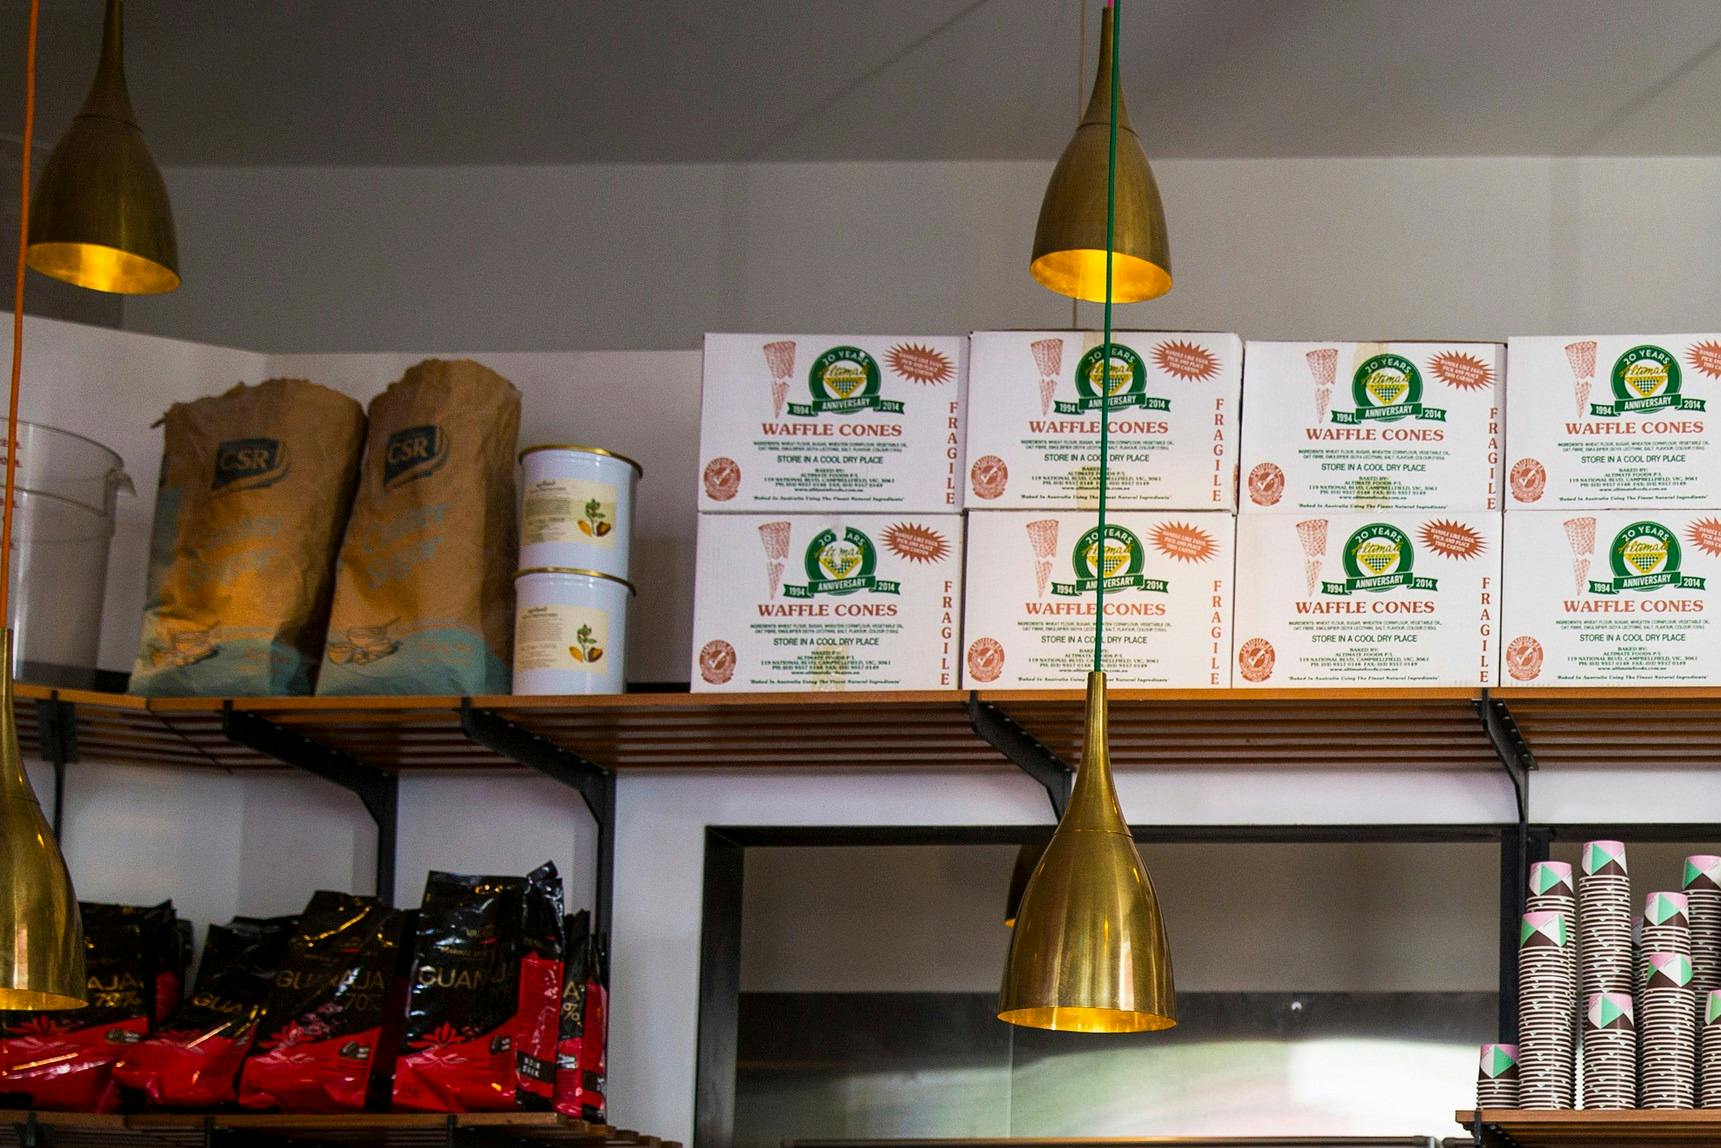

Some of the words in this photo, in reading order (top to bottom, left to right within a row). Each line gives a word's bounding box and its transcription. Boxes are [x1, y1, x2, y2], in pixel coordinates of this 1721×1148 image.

[1112, 347, 1136, 363] EARS
[1623, 353, 1637, 365] 20
[1639, 349, 1670, 365] YEARS
[1365, 361, 1378, 373] 20
[1381, 357, 1412, 374] YEARS
[822, 397, 870, 410] ANNIVERSARY
[882, 403, 899, 412] 2014
[1060, 403, 1076, 412] 1994
[1088, 395, 1136, 408] ANNERSARY
[1149, 400, 1166, 409] 2014
[1596, 406, 1612, 415] 1994
[1624, 396, 1672, 410] ANNIVERSARY
[1684, 401, 1701, 410] 2014
[1336, 413, 1352, 422] 1994
[1365, 405, 1413, 418] ANNIVERSARY
[1425, 410, 1442, 419] 2014
[762, 422, 834, 435] WAFFLE
[839, 423, 902, 436] CONES
[1029, 421, 1099, 433] WAFFLE
[1306, 428, 1375, 440] WAFFLE
[1382, 429, 1444, 441] CONES
[1566, 422, 1636, 435] WAFFLE
[1642, 421, 1704, 434] CONES
[388, 436, 428, 464] CSR
[1213, 398, 1224, 501] FRAGILE
[220, 447, 269, 471] CSR
[777, 456, 803, 464] STORE
[821, 457, 842, 465] COOL
[844, 457, 859, 465] DRY
[860, 457, 884, 465] PLACE
[1044, 454, 1069, 462] STORE
[1071, 454, 1078, 462] IN
[1088, 454, 1108, 462] COO
[1110, 455, 1125, 463] DRY
[1127, 455, 1150, 463] PLACE
[1320, 462, 1346, 470] STORE
[1348, 463, 1355, 471] IN
[1364, 463, 1385, 471] COOL
[1387, 463, 1402, 471] DRY
[1487, 408, 1498, 509] FRAGILE
[1608, 455, 1615, 463] IN
[1624, 455, 1645, 463] COOL
[1647, 455, 1662, 463] DRY
[1663, 455, 1686, 463] PLACE
[846, 529, 865, 546] ARS
[1086, 532, 1099, 544] 20
[1356, 531, 1369, 543] 20
[1371, 526, 1402, 543] YEARS
[1622, 530, 1636, 542] 20
[1638, 525, 1670, 542] YEARS
[789, 586, 805, 596] 1994
[818, 578, 866, 591] ANNIVERSARY
[878, 583, 894, 592] 2014
[1057, 585, 1073, 594] 1994
[1086, 576, 1134, 590] ANVERSARY
[1146, 582, 1163, 591] 2014
[1327, 584, 1343, 593] 1994
[1356, 575, 1403, 588] ANNIVERSARY
[1415, 580, 1432, 589] 2014
[1594, 583, 1610, 592] 1994
[1623, 574, 1671, 587] ANNIVERSARY
[1683, 579, 1700, 588] 2014
[758, 604, 830, 617] WAFFLE
[835, 604, 896, 616] CONES
[1026, 602, 1098, 615] WAFFLE
[1103, 602, 1166, 615] CONES
[1296, 601, 1367, 614] WAFFLE
[1373, 601, 1435, 613] CONES
[1564, 600, 1635, 613] WAFFLE
[1641, 600, 1703, 612] CONES
[1210, 580, 1221, 684] FRAGILE
[1480, 577, 1490, 682] FRAGILE
[773, 638, 799, 646] STORE
[800, 638, 808, 646] IN
[817, 638, 838, 646] COOL
[840, 638, 854, 646] DRY
[856, 638, 879, 646] PLACE
[1042, 636, 1067, 644] STORE
[1068, 636, 1076, 644] IN
[1085, 636, 1106, 644] COL
[1108, 636, 1123, 644] DRY
[1124, 636, 1148, 644] PLACE
[1312, 635, 1337, 643] STORE
[1338, 635, 1346, 643] IN
[1355, 635, 1376, 643] COOL
[1377, 635, 1392, 643] DRY
[1394, 635, 1417, 643] PLACE
[1580, 634, 1605, 642] STORE
[1606, 634, 1614, 642] IN
[1623, 634, 1644, 642] COOL
[1646, 634, 1661, 642] DRY
[1662, 634, 1686, 642] PLACE
[276, 969, 385, 989] GUAJA
[418, 964, 511, 989] GUANJ
